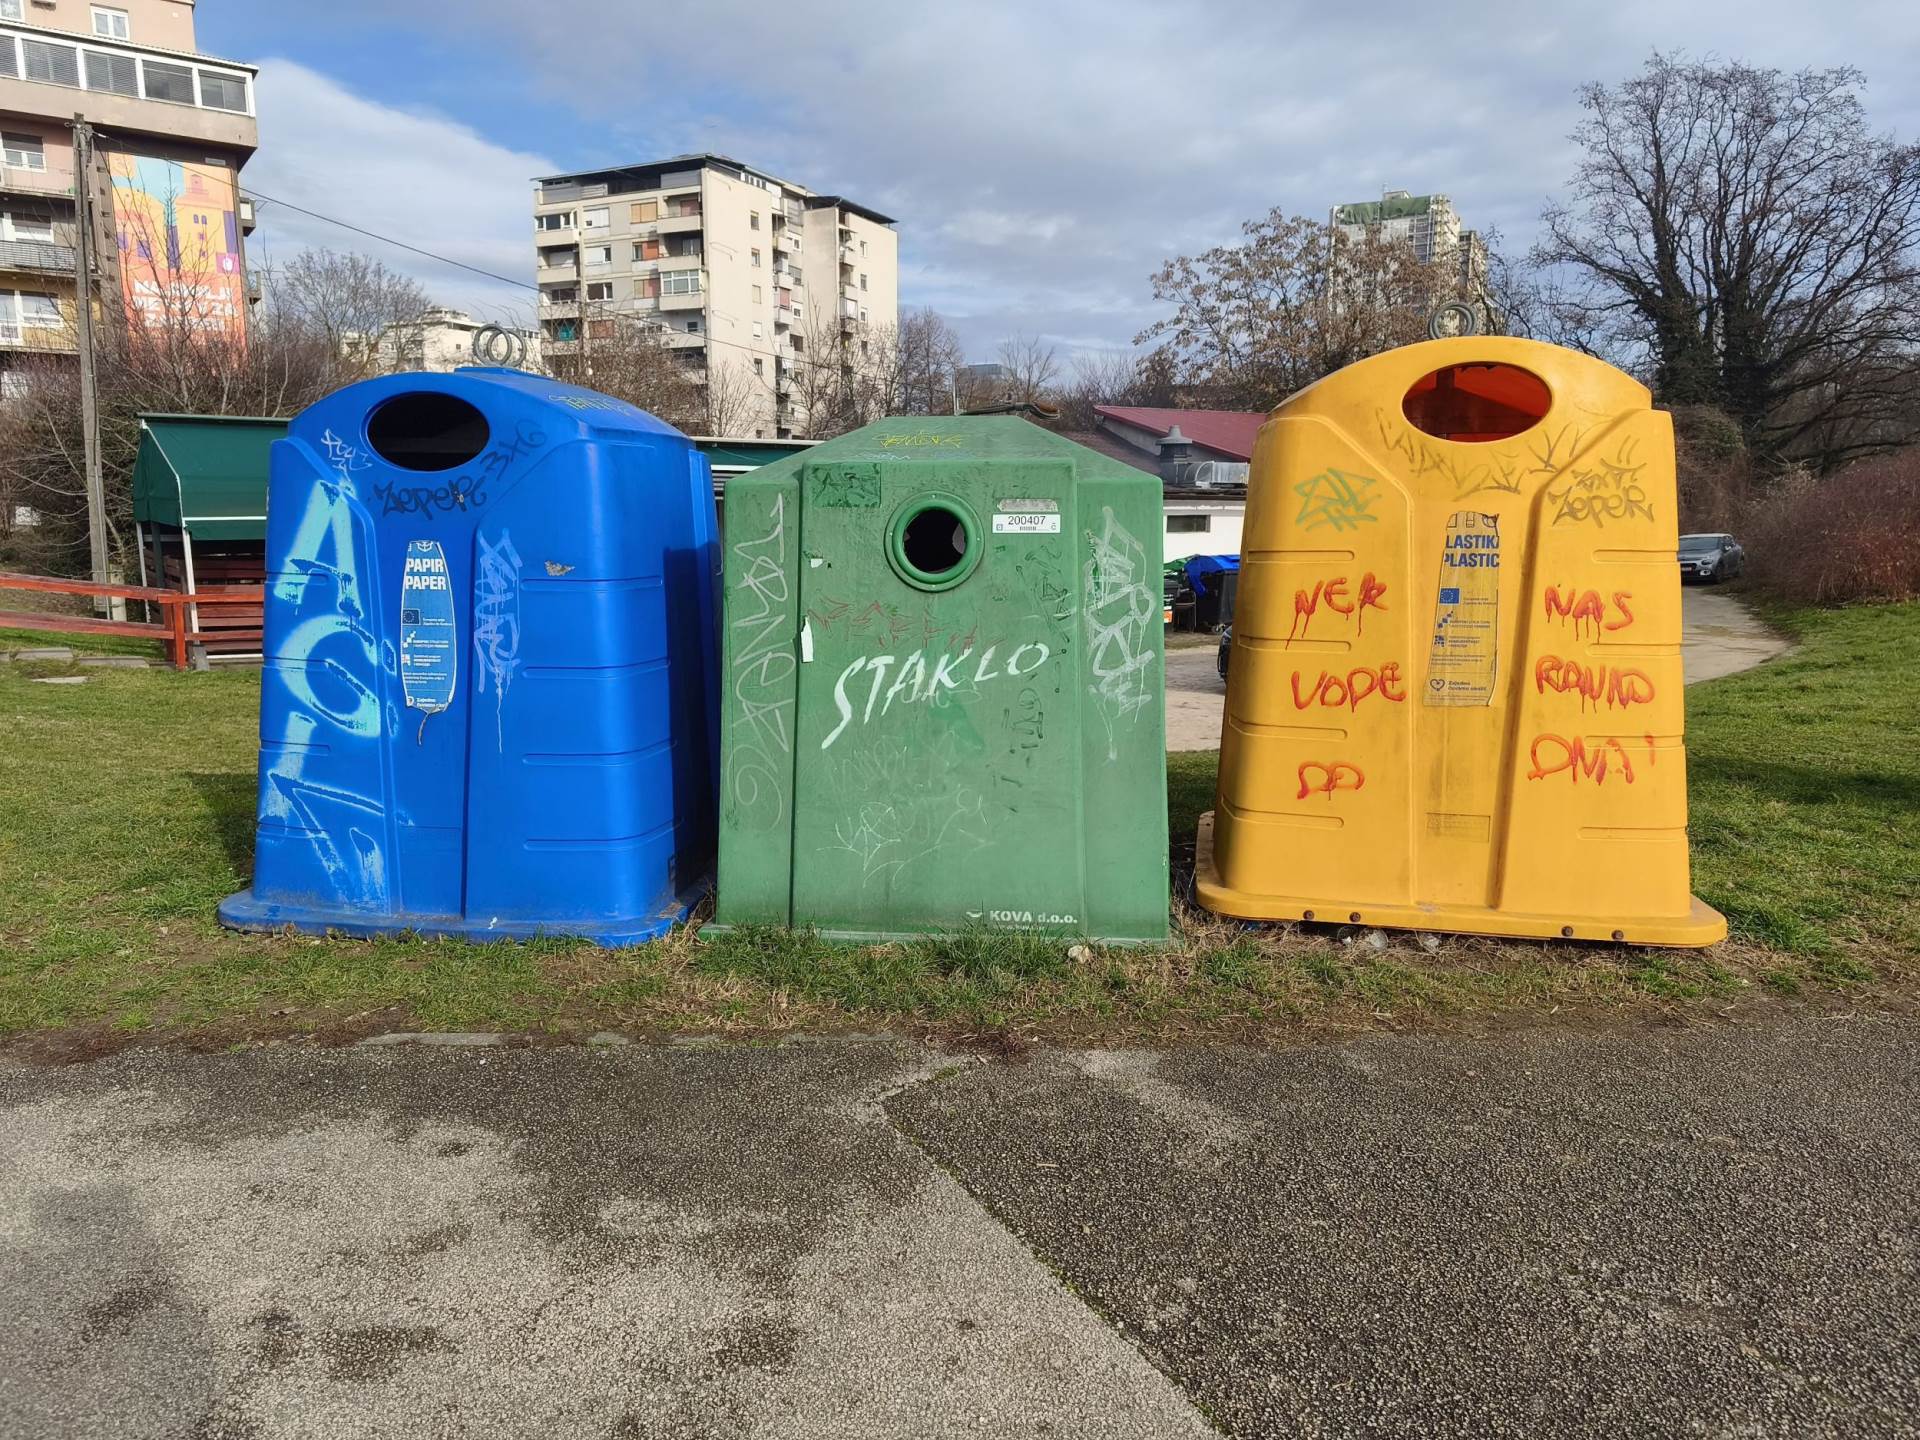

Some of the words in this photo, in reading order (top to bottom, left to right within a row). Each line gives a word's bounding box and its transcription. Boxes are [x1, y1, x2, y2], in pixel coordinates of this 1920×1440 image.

[1007, 515, 1046, 525] 200407
[406, 558, 444, 573] PAPIR
[405, 575, 447, 590] PAPER
[1544, 586, 1634, 638] NAS
[1291, 662, 1407, 712] VODE
[821, 641, 1050, 750] STAKLO
[989, 910, 1032, 922] KOVA
[1037, 912, 1078, 924] d.o.o.
